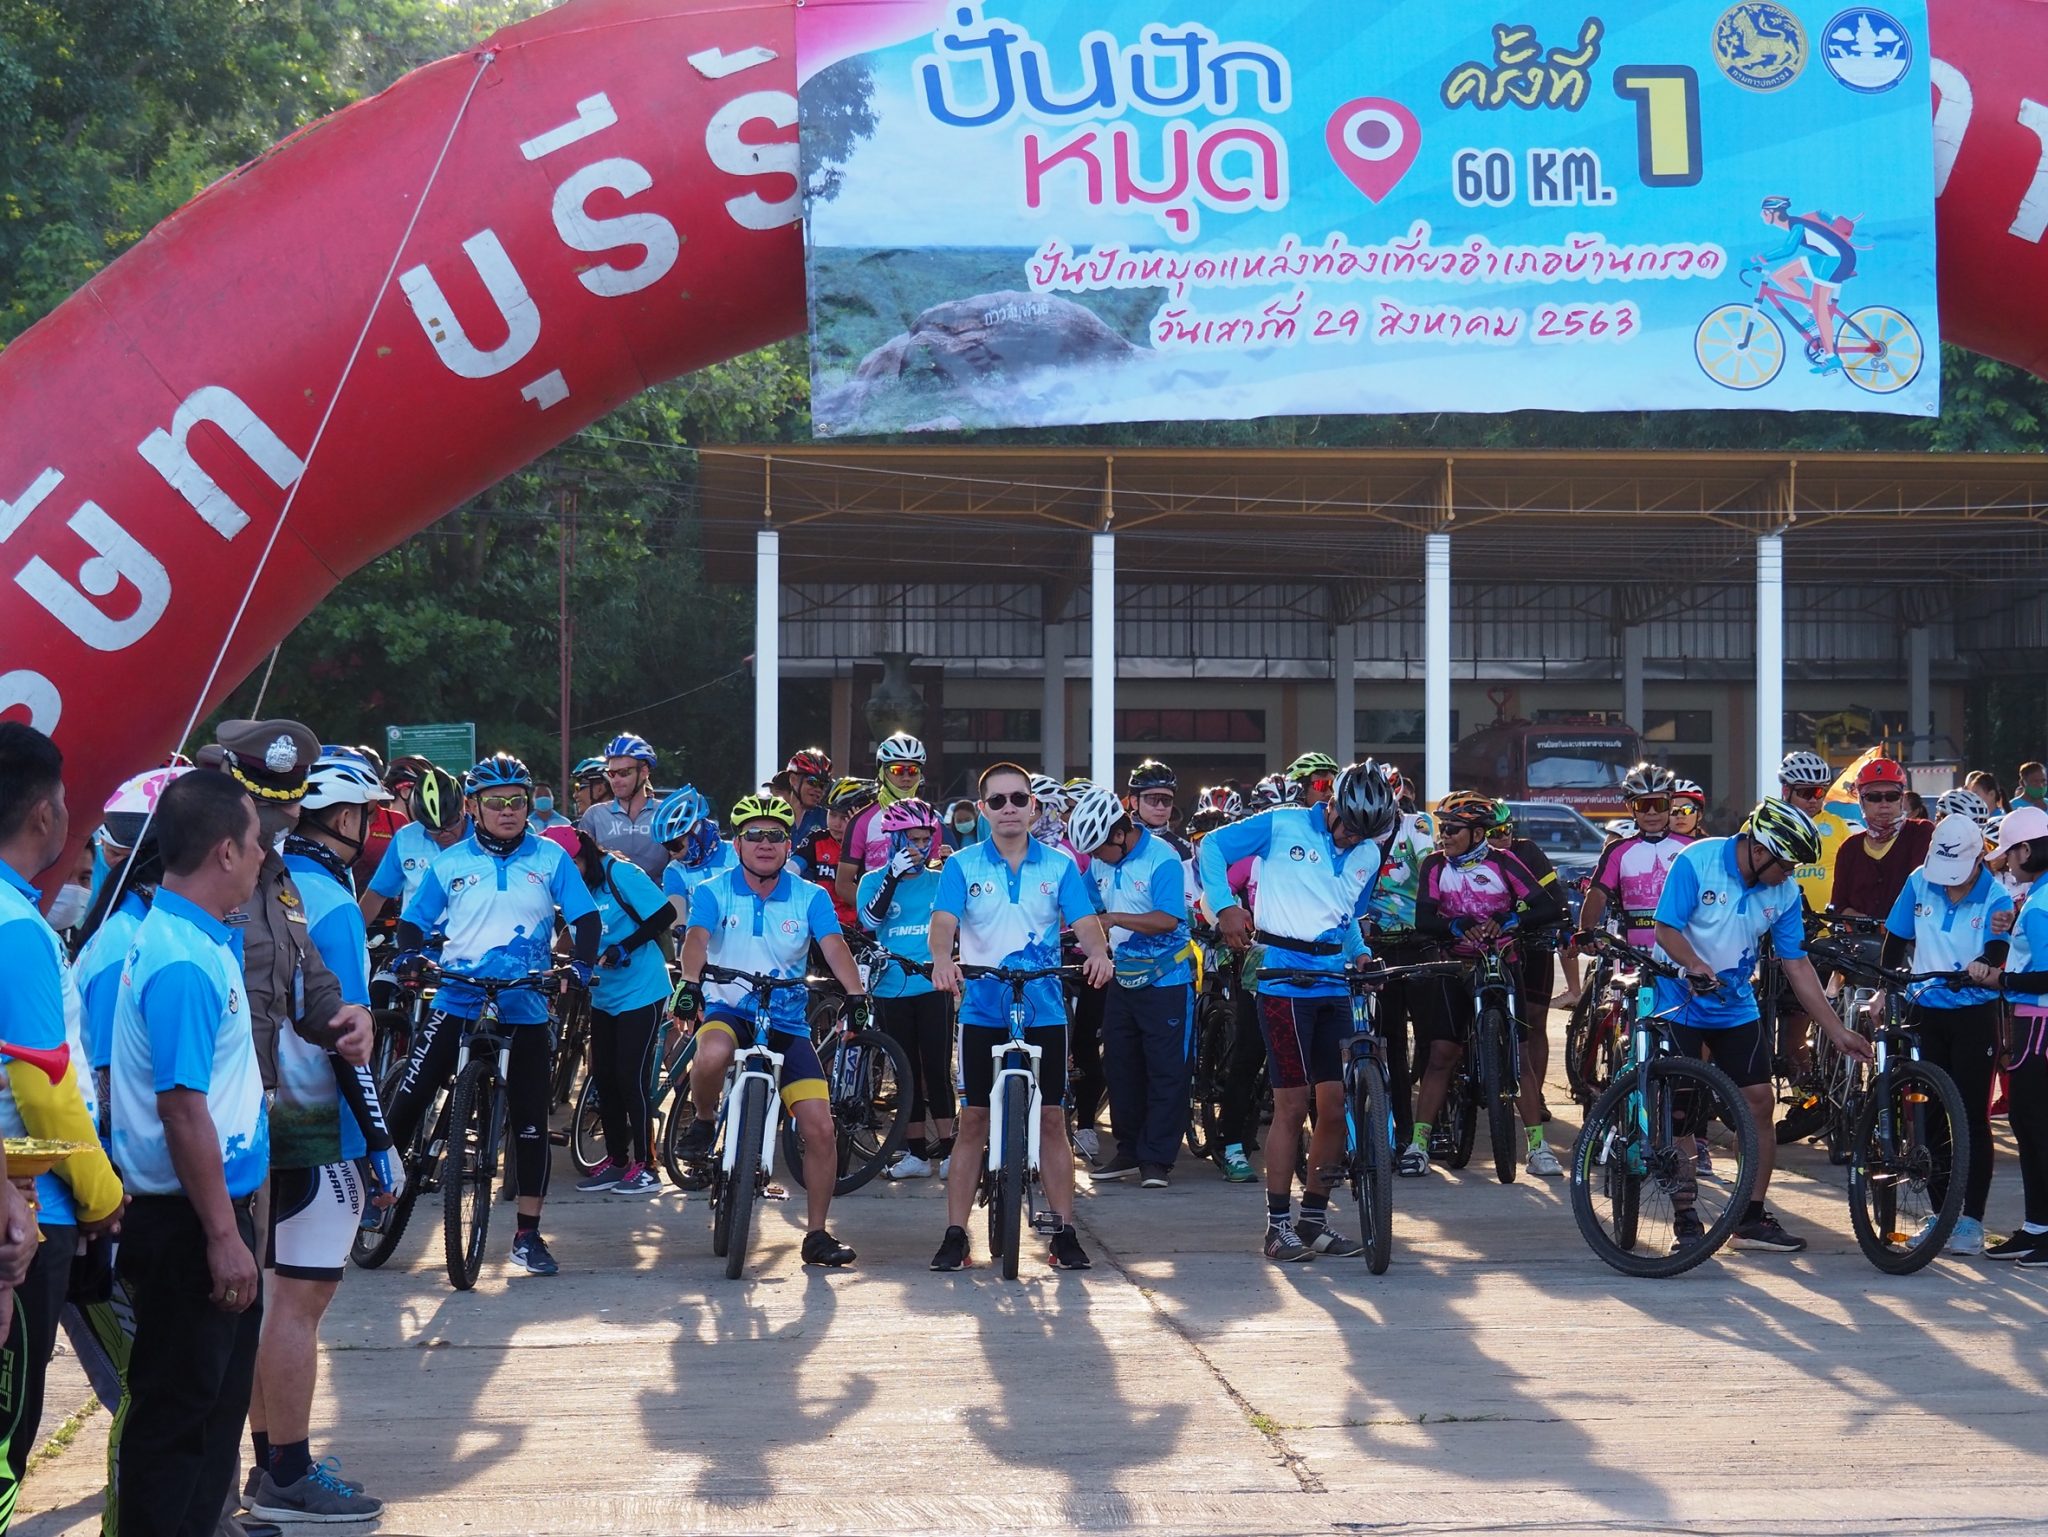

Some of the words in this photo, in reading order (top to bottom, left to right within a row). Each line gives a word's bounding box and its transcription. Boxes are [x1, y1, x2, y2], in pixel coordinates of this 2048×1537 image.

[921, 6, 1282, 128] ปั่นปัก
[1446, 25, 1598, 108] ครั้งที่
[1621, 72, 1696, 180] 1
[1023, 127, 1281, 233] หมุด
[1458, 151, 1511, 203] 60
[1532, 150, 1614, 203] KM.
[1033, 227, 1721, 298] ปั่นปักหมุดแหล่งท่องเที่ยวอำเภอบ้านกรวด
[1158, 291, 1304, 344] วันเสาร์ที่
[1312, 309, 1359, 337] 29
[1378, 302, 1519, 338] สิงหาคม
[1537, 308, 1634, 337] 2563
[399, 1008, 448, 1094] THAILAND
[1577, 1116, 1598, 1179] BONTRAGER
[339, 1160, 360, 1216] OWEREDBY
